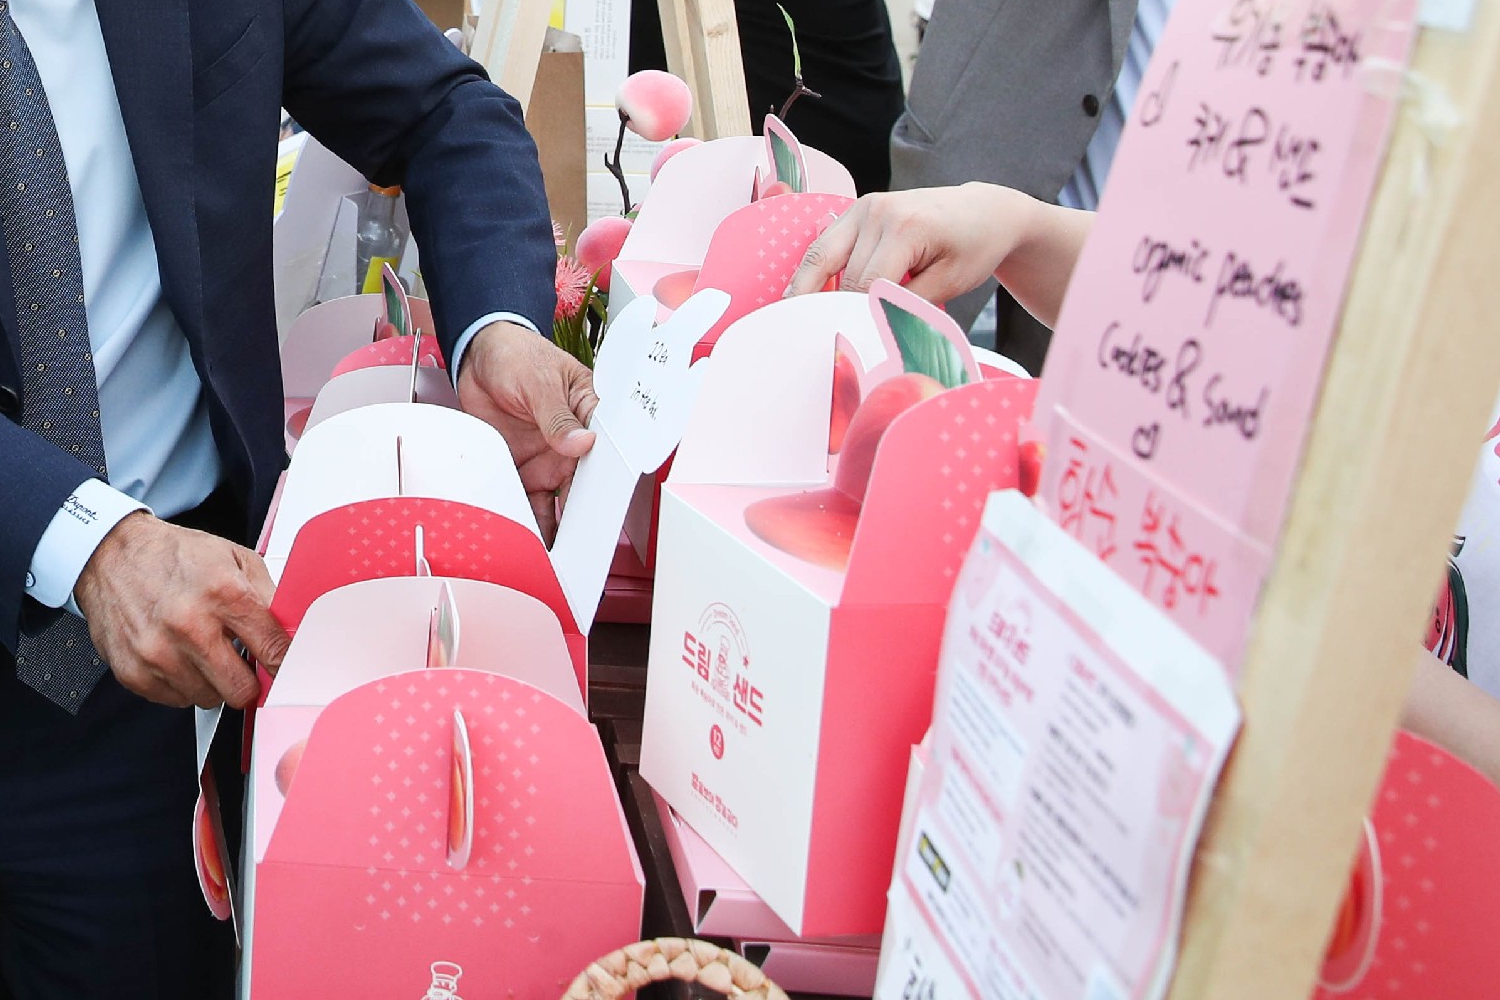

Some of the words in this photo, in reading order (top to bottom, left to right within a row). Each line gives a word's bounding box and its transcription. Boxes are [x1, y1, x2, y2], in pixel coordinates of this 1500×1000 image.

[681, 630, 712, 683] 드림
[732, 673, 764, 728] 샌드
[713, 728, 721, 748] 12
